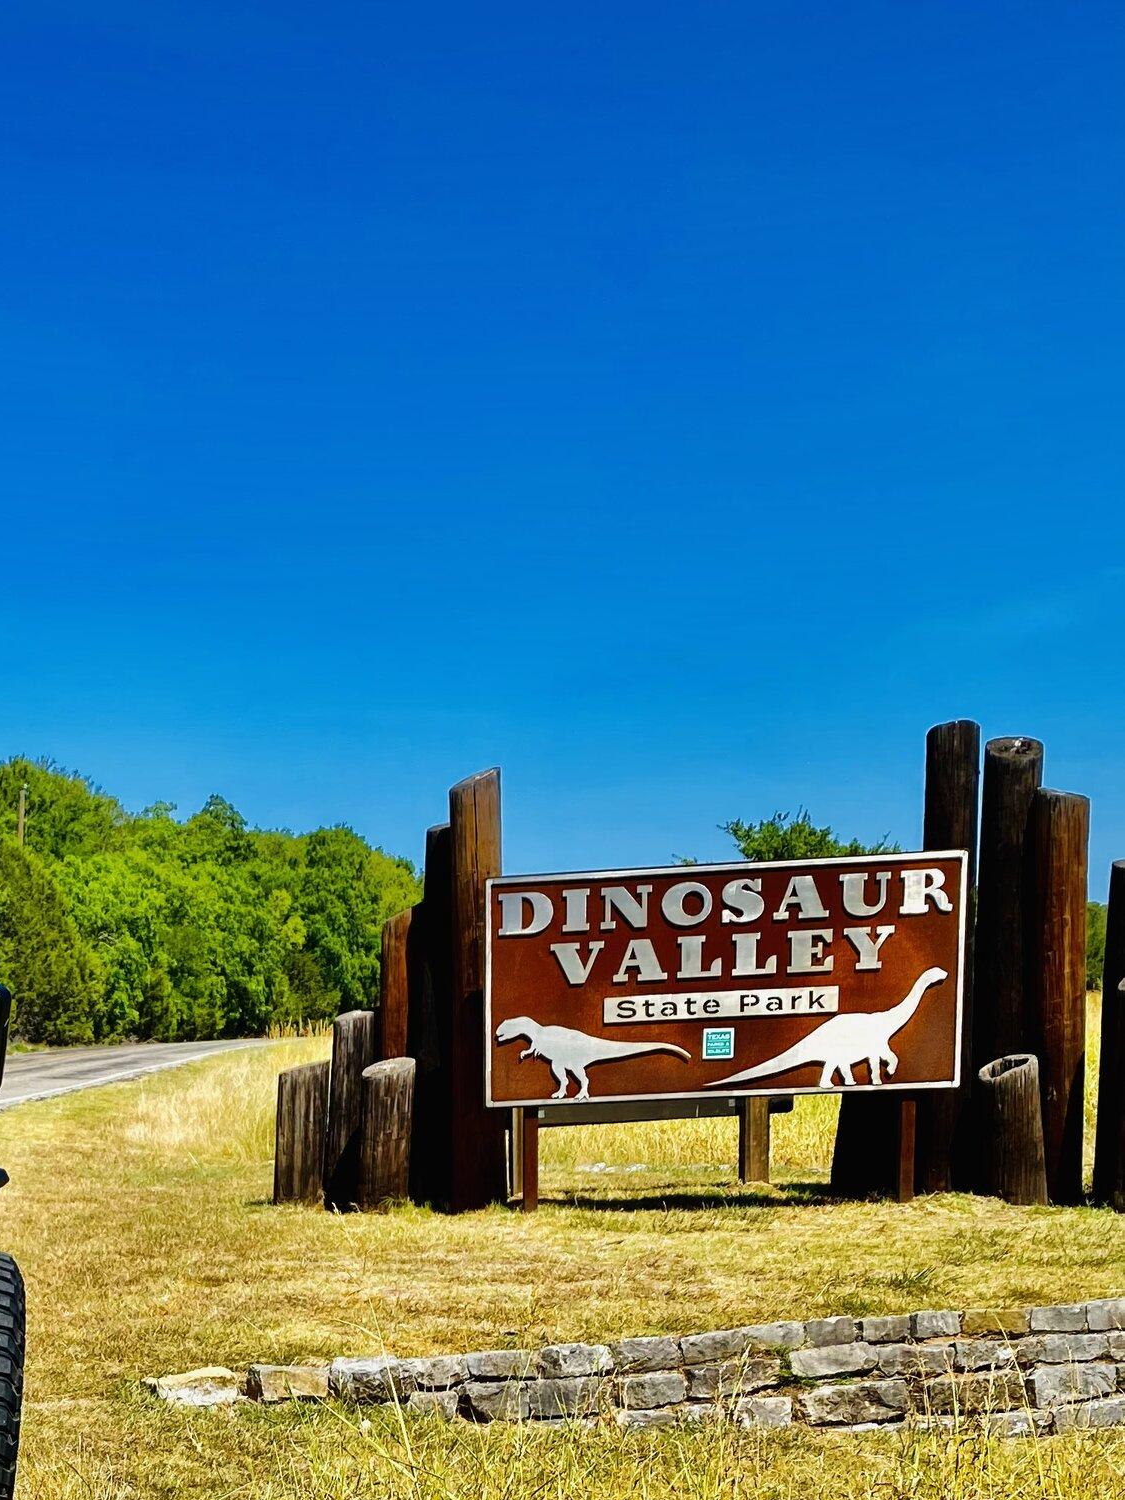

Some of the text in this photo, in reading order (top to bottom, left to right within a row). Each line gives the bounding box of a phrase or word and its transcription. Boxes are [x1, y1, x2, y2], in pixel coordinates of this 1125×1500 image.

[498, 868, 954, 937] DINOSAUR
[550, 925, 896, 985] VALLEY
[616, 990, 825, 1019] State Park
